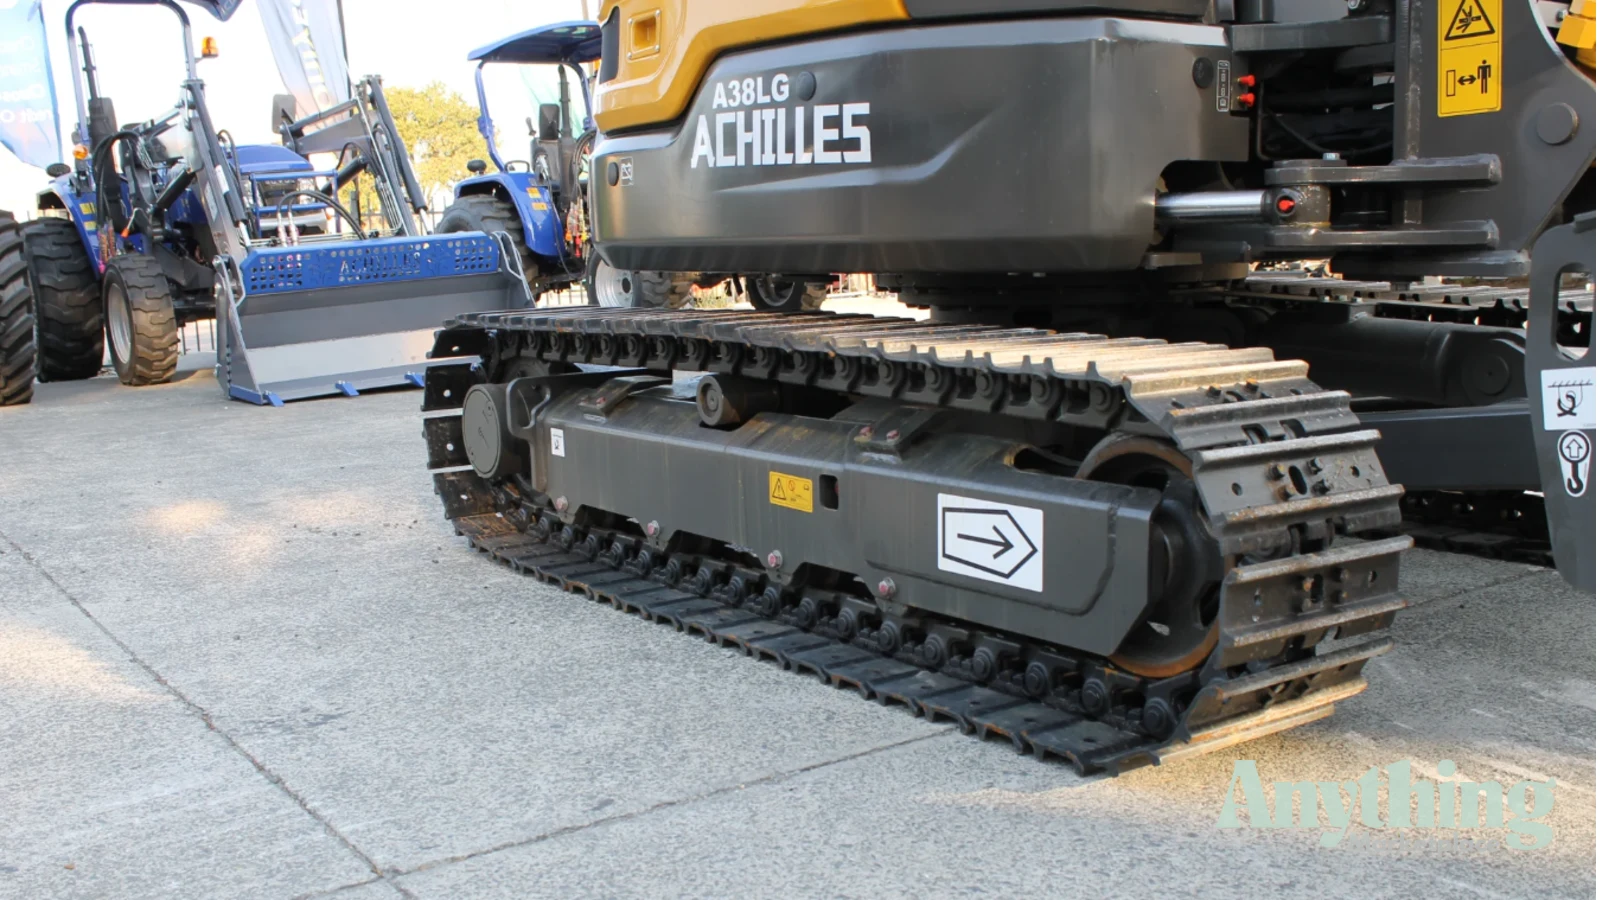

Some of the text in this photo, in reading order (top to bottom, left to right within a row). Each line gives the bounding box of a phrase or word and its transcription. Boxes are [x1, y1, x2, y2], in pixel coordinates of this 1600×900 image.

[713, 73, 790, 110] A38LG
[690, 102, 872, 168] ACHILLES
[340, 252, 421, 275] ACHILLES
